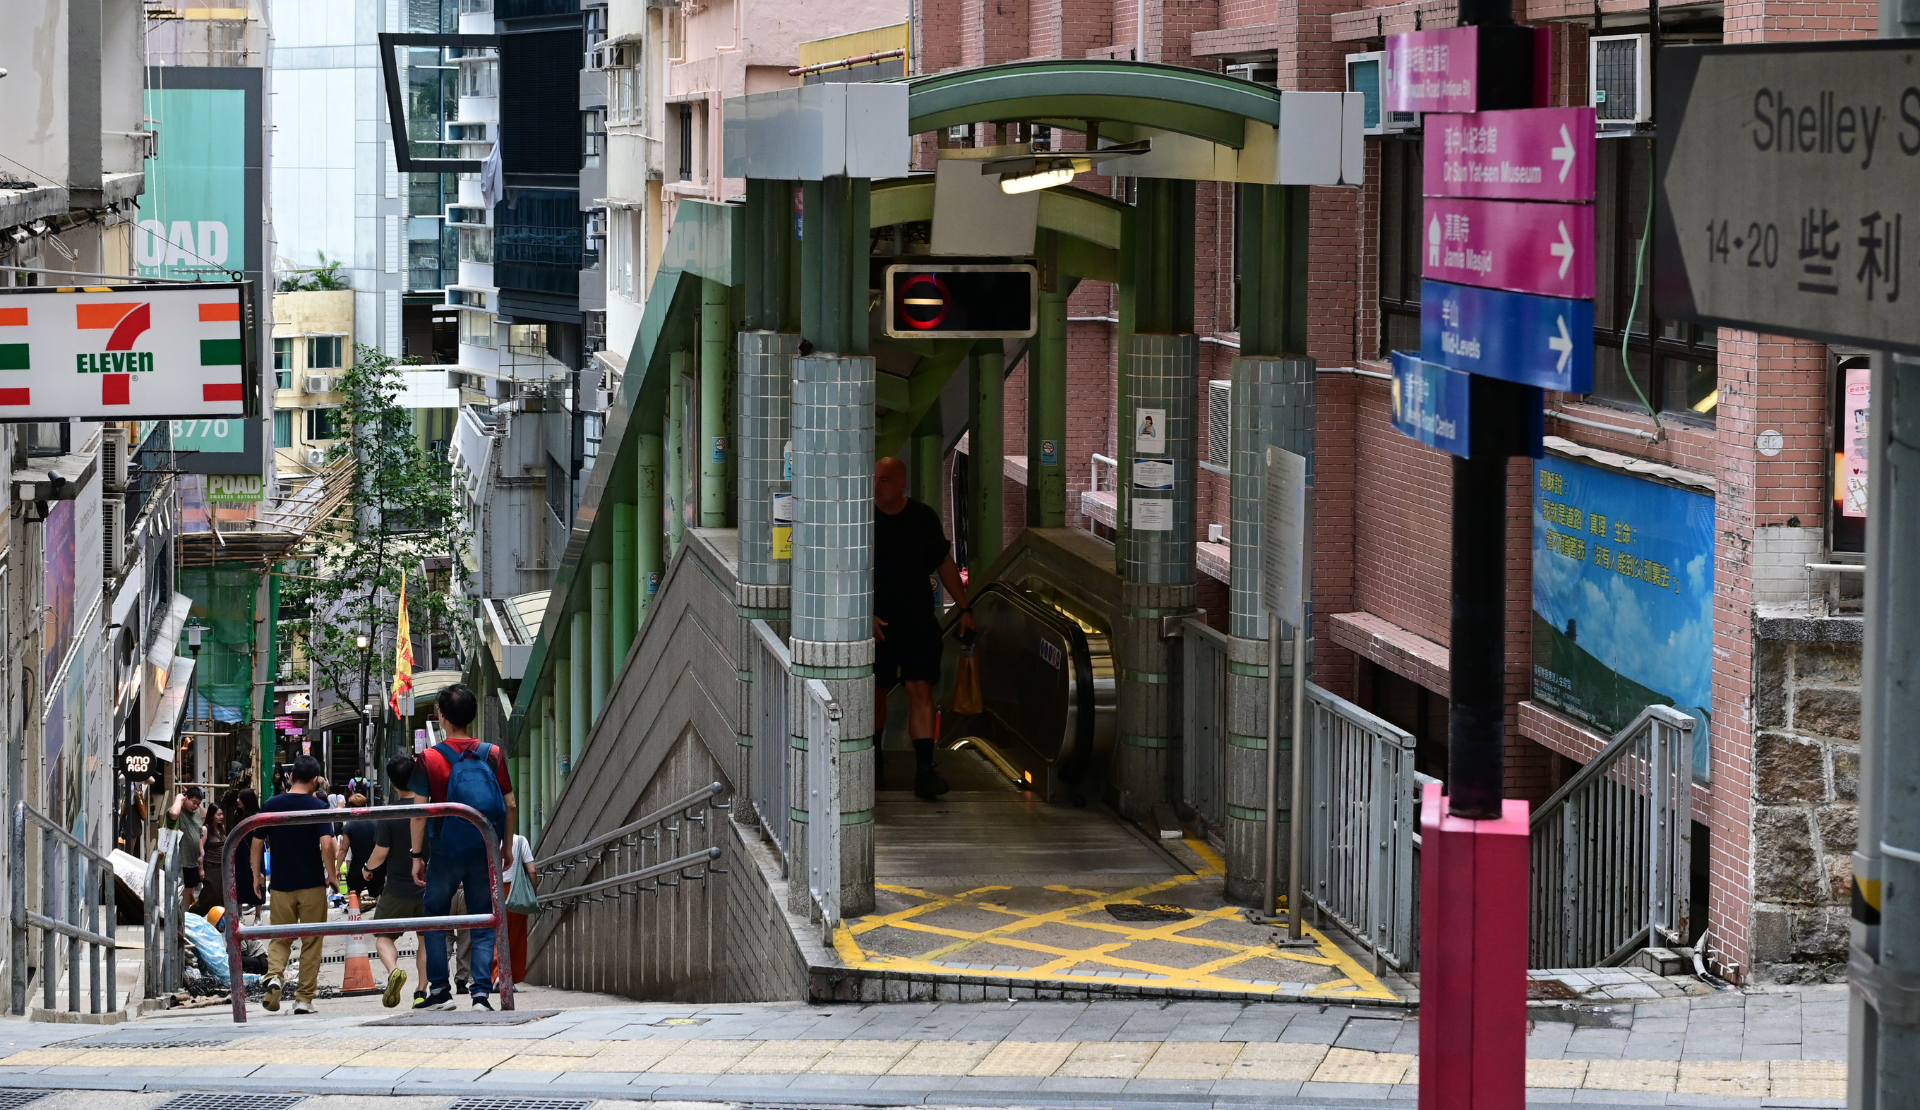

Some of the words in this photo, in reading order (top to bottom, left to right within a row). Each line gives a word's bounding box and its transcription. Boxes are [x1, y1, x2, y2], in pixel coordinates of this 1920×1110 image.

[1444, 126, 1497, 155] 孫中山紀念館
[1753, 87, 1881, 170] Shelley
[1899, 86, 1920, 156] S
[1443, 161, 1453, 182] Dr
[1453, 161, 1468, 182] Sun
[1468, 161, 1500, 183] Yat-sen
[1501, 161, 1542, 183] Museum
[137, 218, 229, 267] OAD
[1798, 207, 1901, 303] 些利
[1444, 246, 1466, 269] Jama
[1466, 248, 1493, 277] Masjid
[1441, 298, 1459, 328] 半山
[76, 302, 151, 405] 7
[1441, 331, 1481, 360] Mid-Levels
[209, 474, 261, 495] POAD
[126, 755, 150, 765] AMO
[127, 764, 148, 773] AGO
